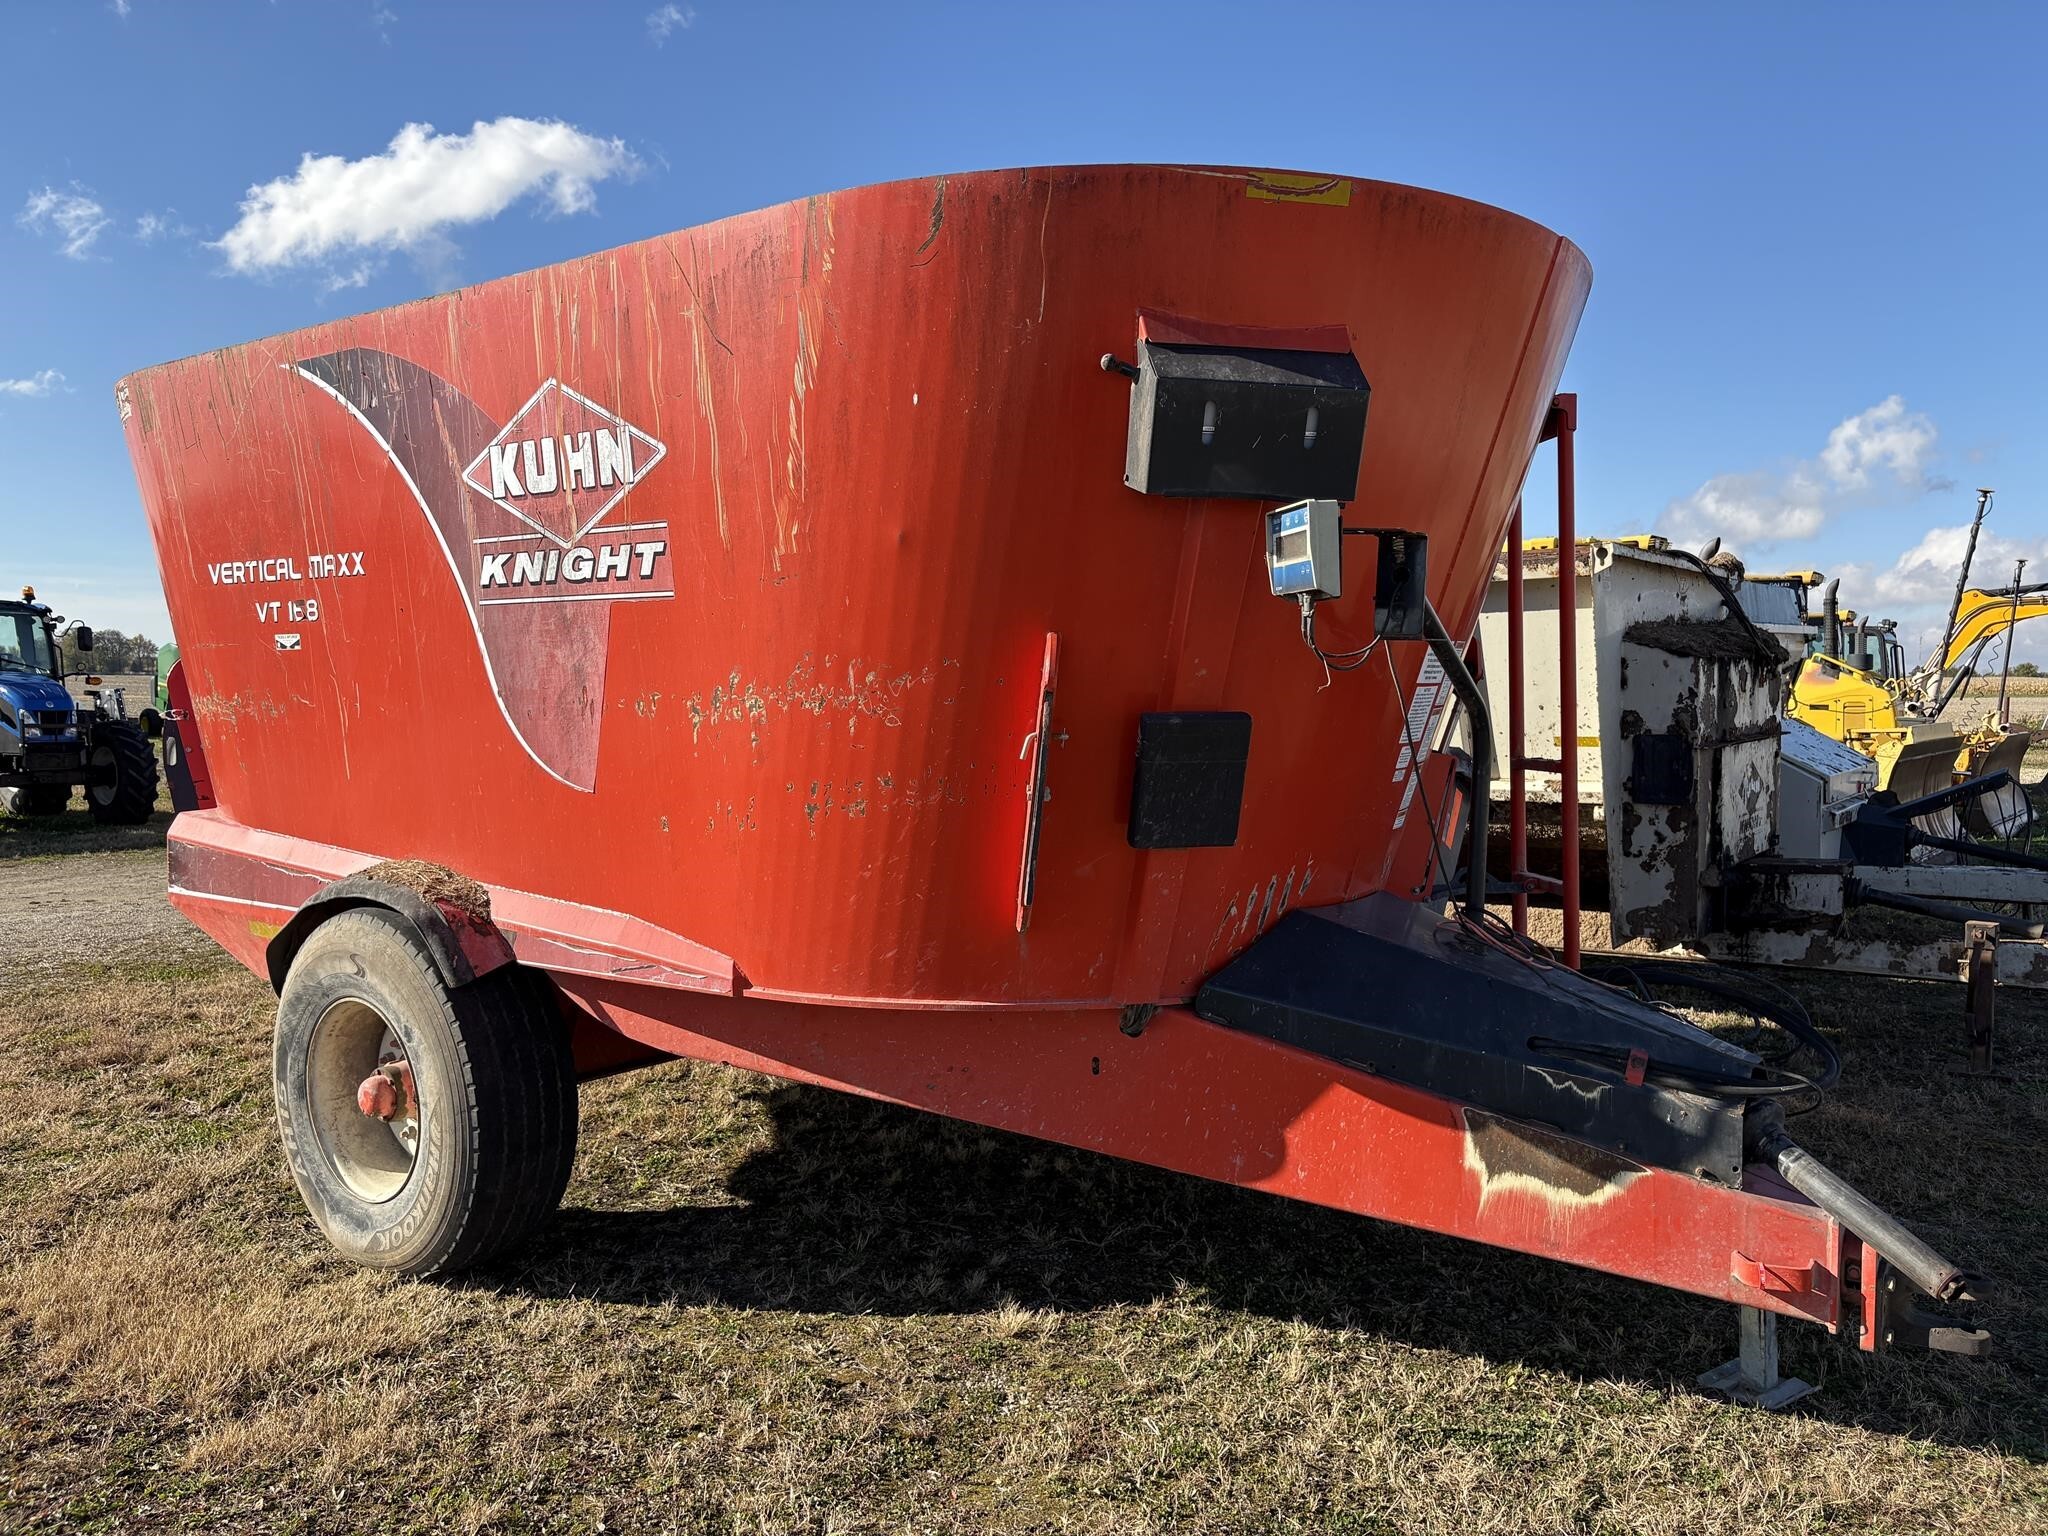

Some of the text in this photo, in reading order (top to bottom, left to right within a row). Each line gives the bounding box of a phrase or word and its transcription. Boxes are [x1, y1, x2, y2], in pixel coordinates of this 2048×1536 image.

[489, 425, 635, 499] KUHN
[208, 551, 366, 585] VERTICAL MAXX
[480, 541, 666, 588] KNIGHT
[255, 601, 282, 623] VT
